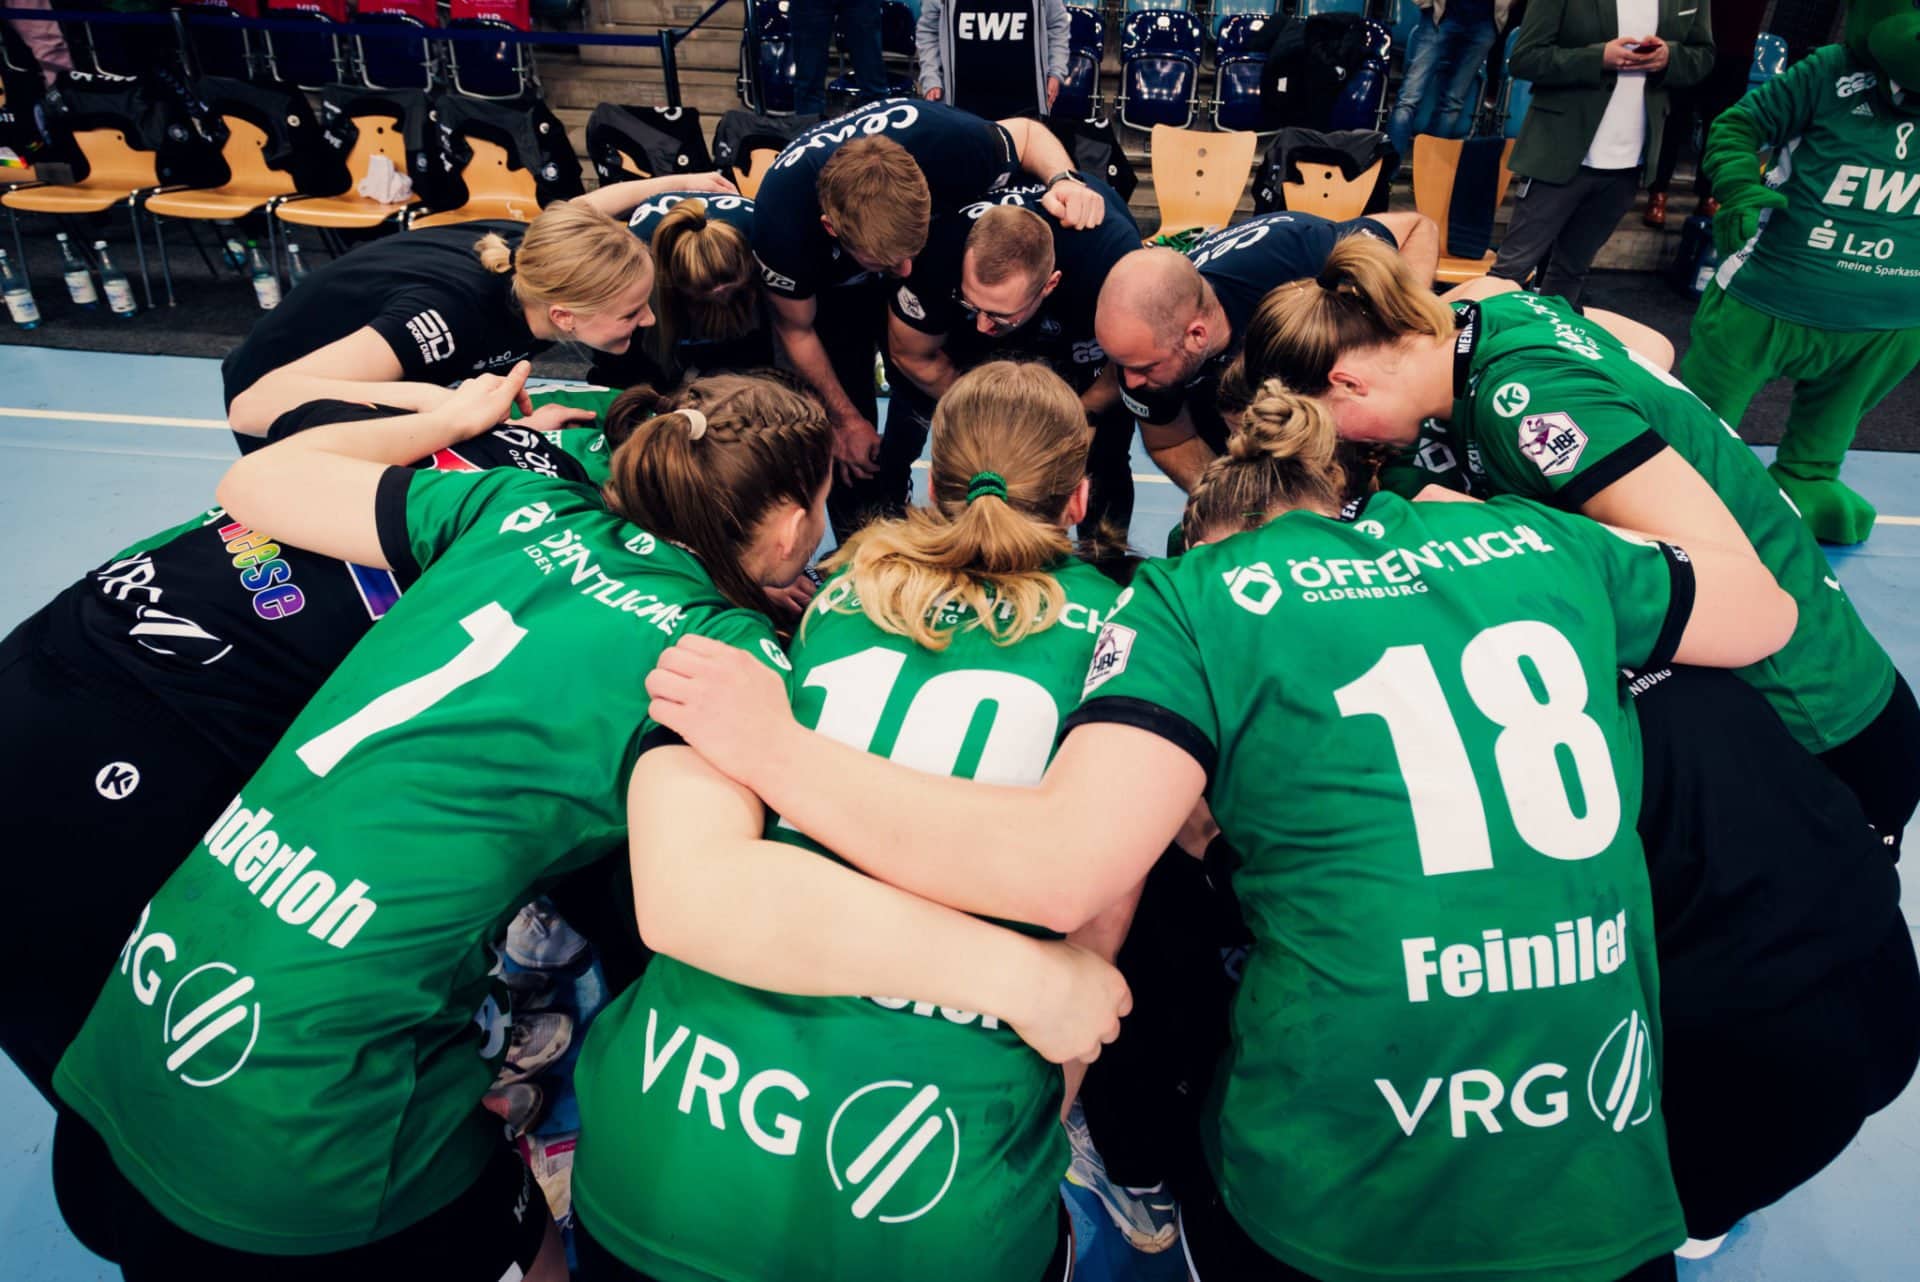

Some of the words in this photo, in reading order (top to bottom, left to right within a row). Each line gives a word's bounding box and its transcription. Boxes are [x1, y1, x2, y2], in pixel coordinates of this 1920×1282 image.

[959, 12, 1027, 40] EWE
[1822, 164, 1920, 215] EW
[1842, 233, 1895, 259] LzO
[1836, 259, 1873, 273] meine
[1547, 428, 1578, 456] HBF
[1302, 581, 1429, 603] OLDENBURG
[1335, 619, 1621, 876] 18
[642, 1008, 810, 1156] VRG
[1375, 1062, 1569, 1138] VRG
